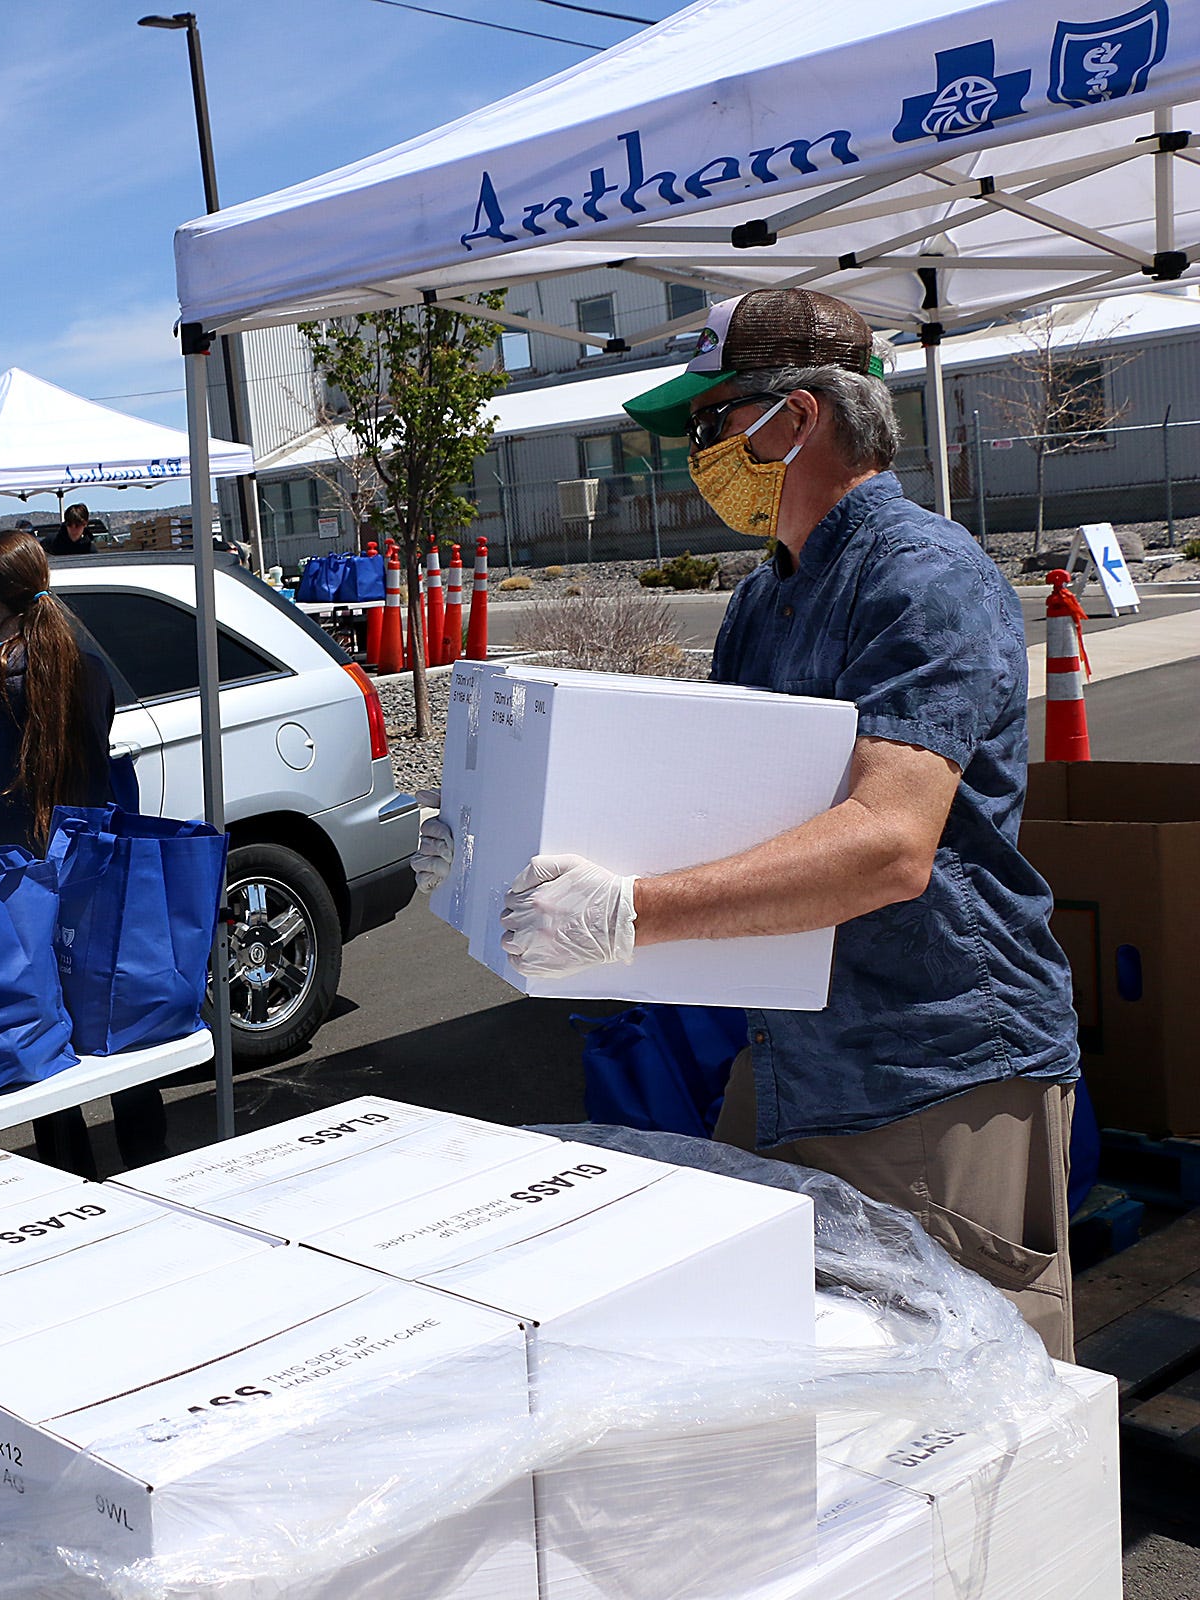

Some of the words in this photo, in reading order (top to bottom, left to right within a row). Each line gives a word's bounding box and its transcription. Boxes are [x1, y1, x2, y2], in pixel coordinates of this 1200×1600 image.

[460, 129, 861, 252] Anthem
[297, 1112, 391, 1146] GLASS
[509, 1163, 608, 1204] GLASS
[451, 1198, 507, 1222] HANDLE
[459, 1216, 491, 1231] SIDE
[488, 1203, 523, 1219] THIS
[413, 1218, 451, 1236] WITH
[438, 1226, 460, 1240] UP
[374, 1233, 416, 1251] CARE
[263, 1363, 307, 1385] THIS
[305, 1347, 347, 1368] SIDE
[345, 1335, 369, 1352] UP
[279, 1359, 353, 1390] HANDLE
[351, 1338, 396, 1361] WITH
[393, 1317, 442, 1341] CARE
[3, 1468, 25, 1495] AG
[95, 1493, 135, 1533] 9WL
